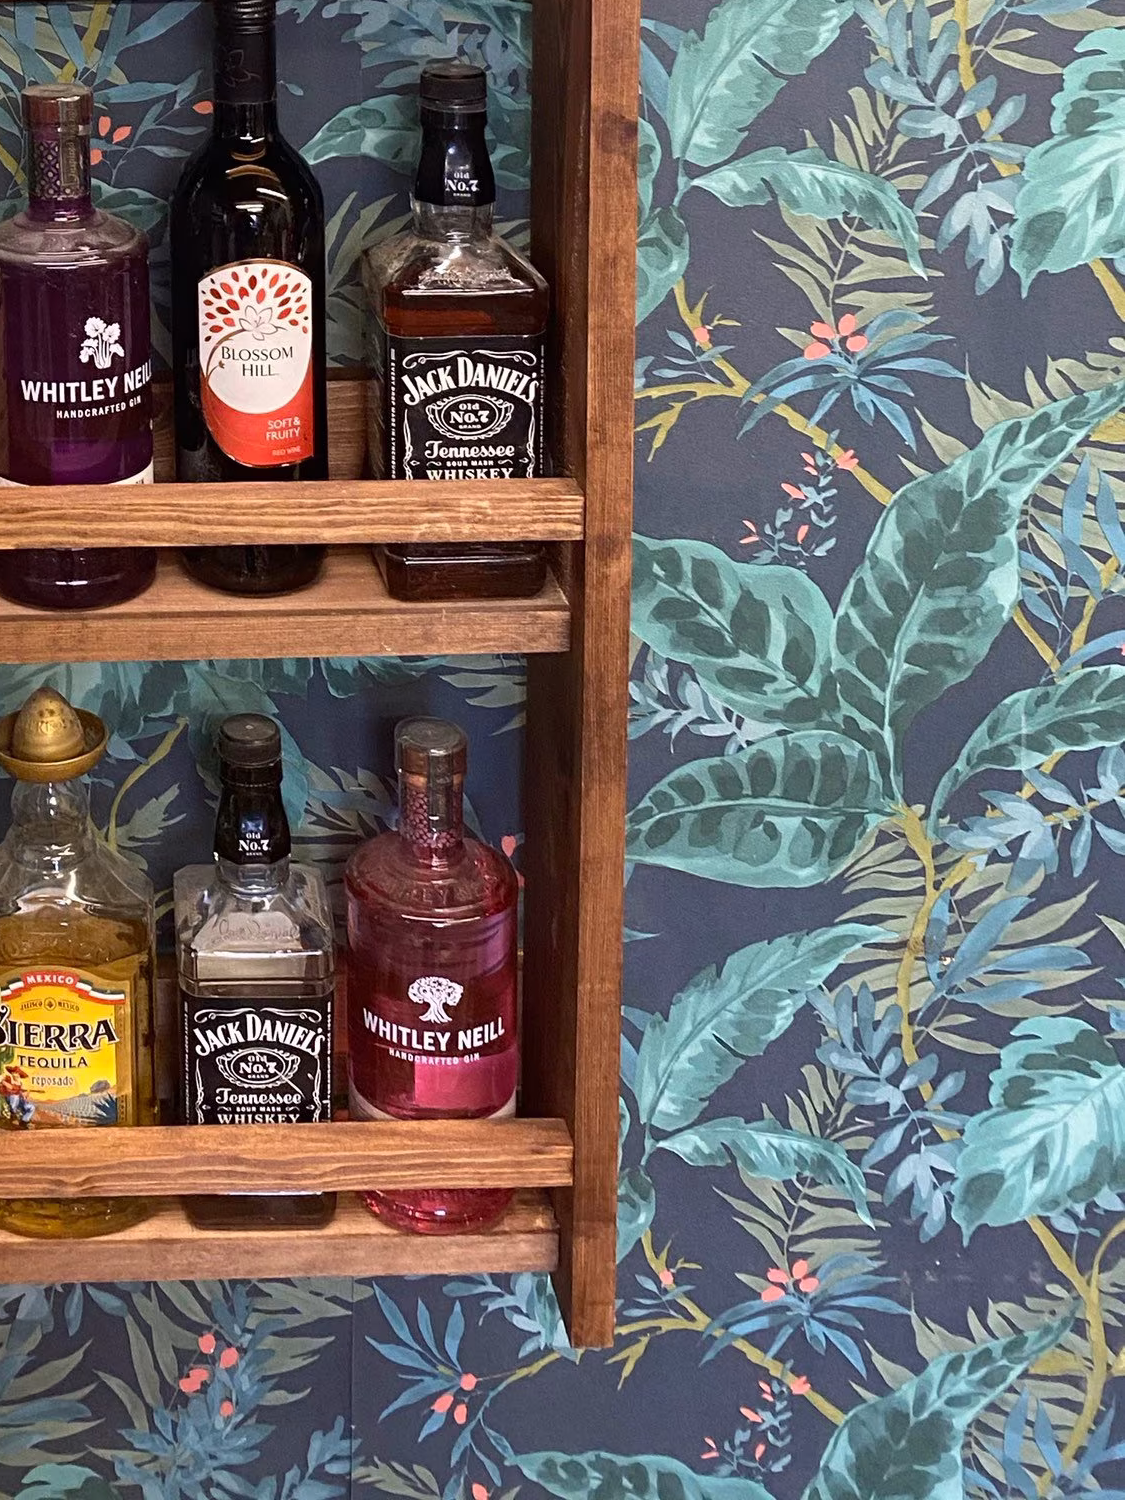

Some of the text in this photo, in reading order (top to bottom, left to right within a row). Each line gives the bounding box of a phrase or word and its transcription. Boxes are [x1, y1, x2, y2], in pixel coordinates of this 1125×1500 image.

[445, 179, 479, 192] No.7
[221, 346, 293, 361] BLOSSOM
[242, 363, 275, 377] HILL
[20, 376, 118, 403] WHITLEY
[401, 365, 456, 406] JACK
[56, 395, 142, 419] HANDCRAFTED GIN
[458, 402, 480, 411] Old
[267, 416, 301, 430] SOFT &
[450, 410, 490, 424] No.7
[266, 426, 301, 440] FRUITY
[424, 440, 515, 459] Tennessee
[426, 468, 514, 481] WHISKEY
[238, 839, 270, 851] No.7
[26, 974, 75, 986] MEXICO
[363, 1007, 505, 1051] WHITLEY NEILL
[193, 1020, 245, 1056] JACK
[17, 1055, 88, 1069] TEQUILA
[388, 1048, 481, 1066] HANDCRAFTED GIN
[239, 1062, 277, 1074] No.7
[31, 1076, 74, 1087] reposado
[215, 1088, 302, 1105] Tennessee
[217, 1113, 300, 1125] WHISKEY
